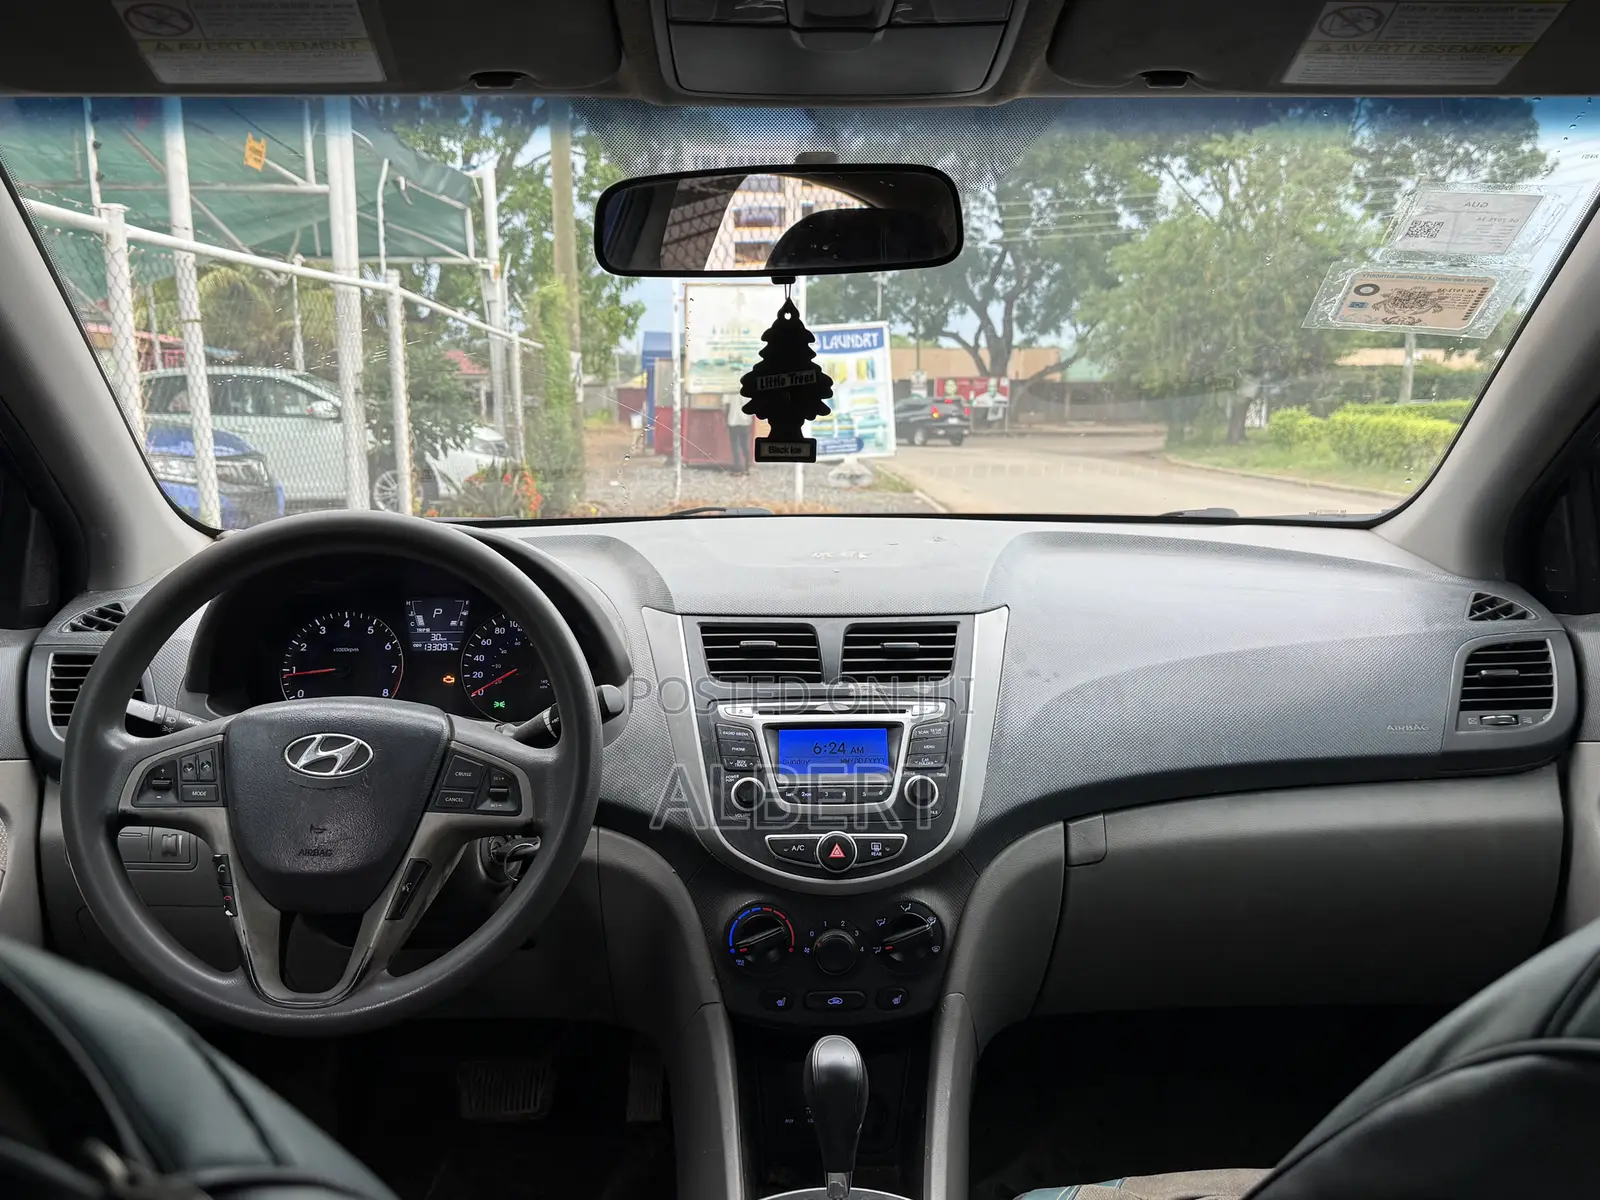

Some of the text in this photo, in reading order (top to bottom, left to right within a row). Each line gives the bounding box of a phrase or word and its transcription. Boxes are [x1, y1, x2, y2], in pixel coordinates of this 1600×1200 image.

[822, 332, 880, 351] LAUNDRY
[760, 371, 816, 390] Little Trees
[768, 445, 790, 454] Black
[432, 608, 443, 619] P
[344, 620, 351, 628] 4
[319, 626, 326, 635] 3
[367, 626, 374, 635] 5
[494, 627, 506, 635] 80
[384, 642, 392, 651] 6
[480, 638, 492, 646] 60
[300, 643, 307, 652] 2
[473, 654, 485, 662] 40
[391, 665, 398, 673] 7
[472, 671, 484, 679] 20
[297, 689, 304, 698] 0
[382, 688, 389, 697] 8
[1386, 724, 1430, 732] AIRBAG
[813, 741, 865, 755] 6:24 AM
[297, 848, 334, 858] AIRBAG
